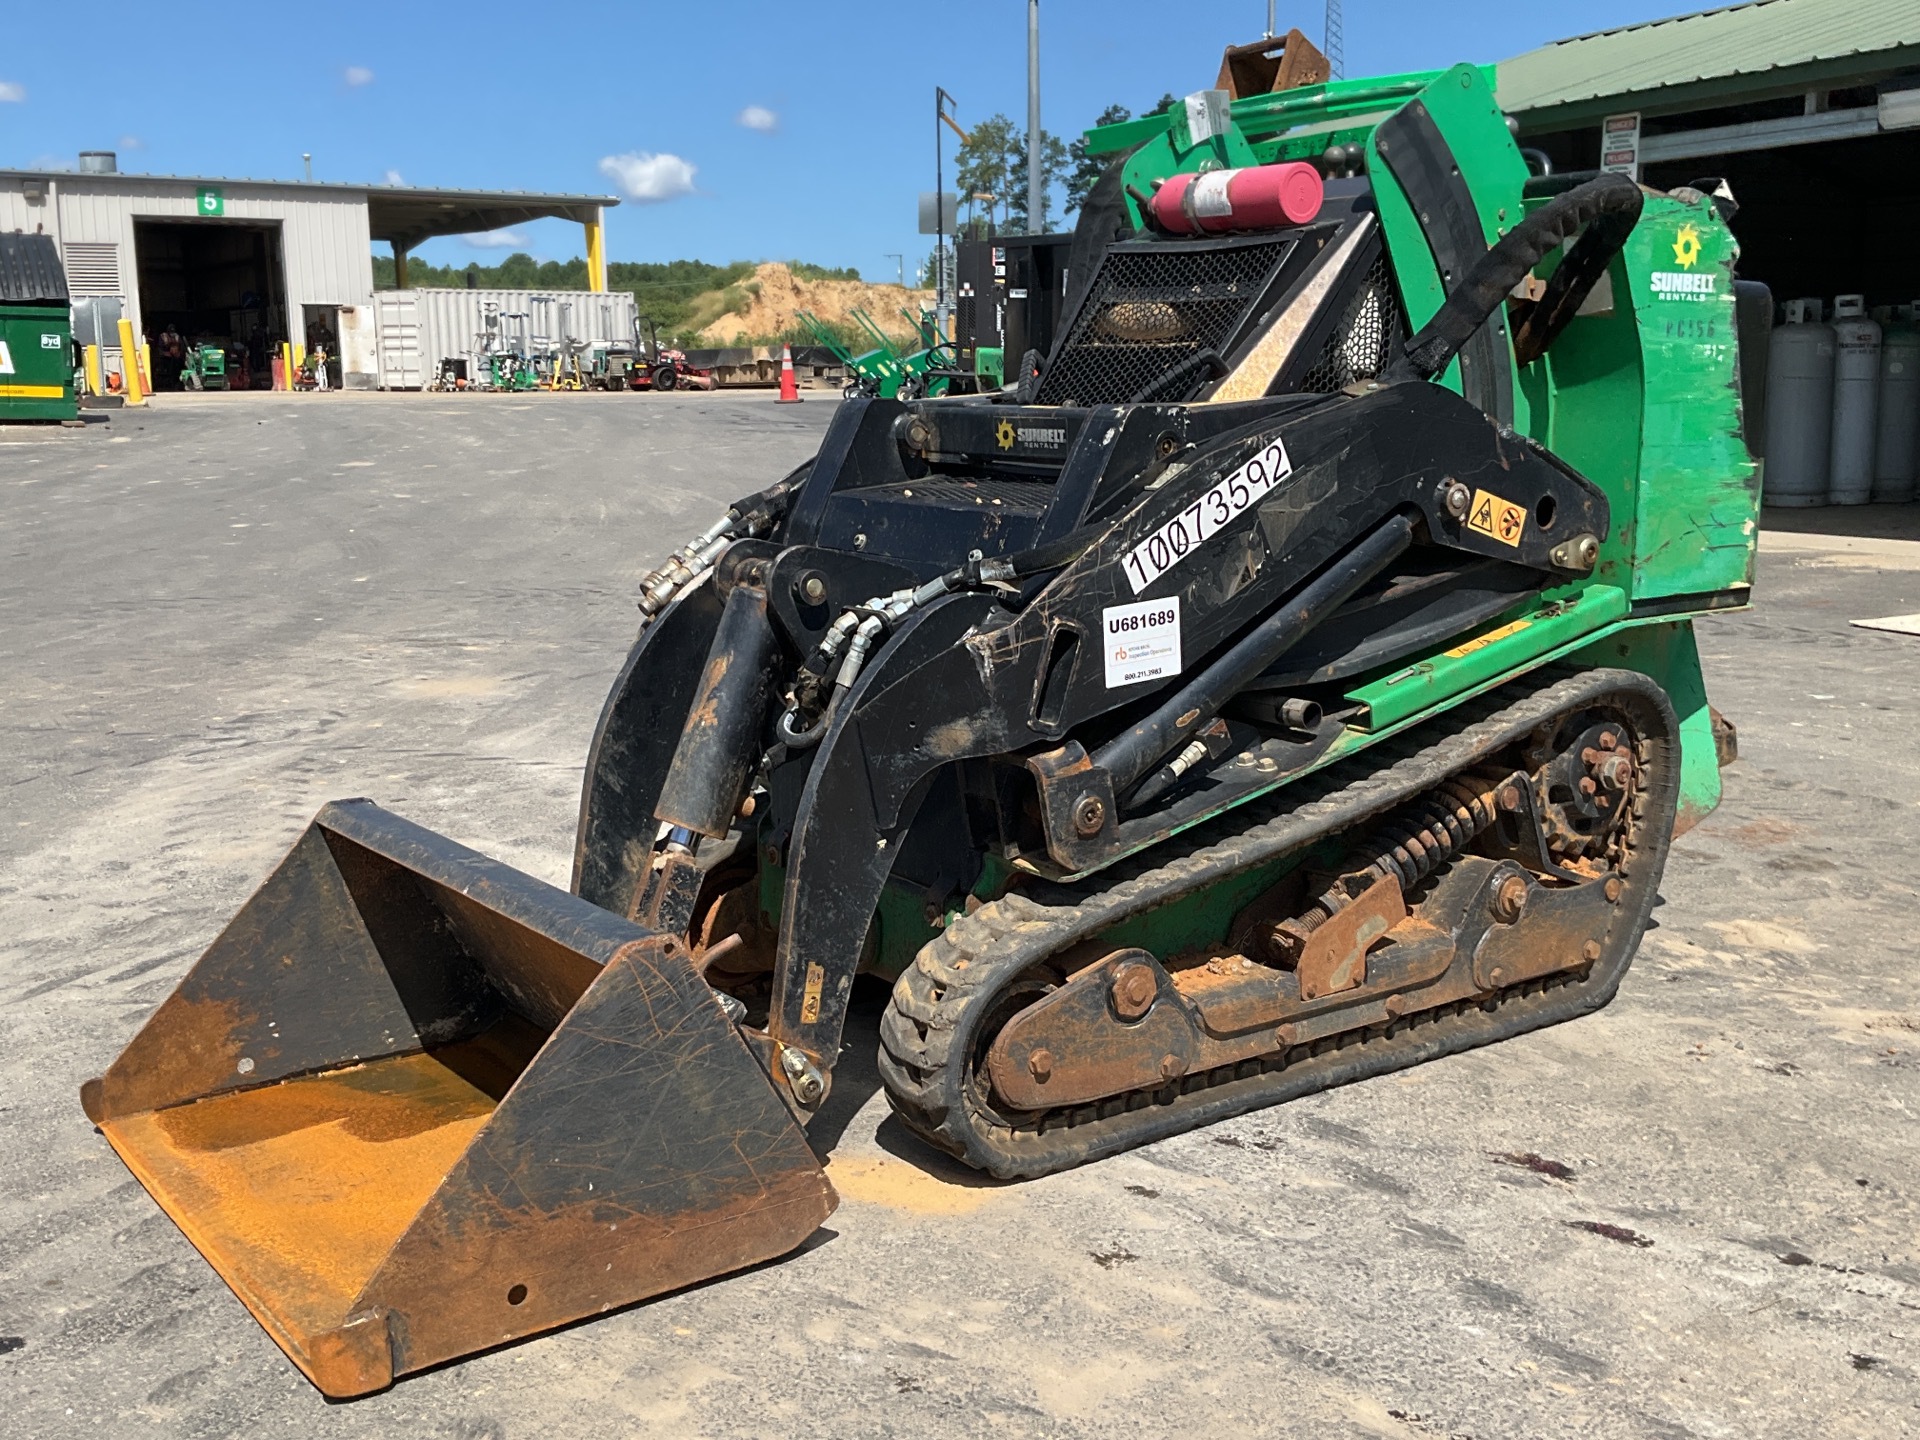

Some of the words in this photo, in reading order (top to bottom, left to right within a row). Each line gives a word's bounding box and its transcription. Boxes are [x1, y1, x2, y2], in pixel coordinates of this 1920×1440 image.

[204, 192, 217, 210] 5
[1650, 272, 1717, 293] SUNBELT
[1658, 292, 1706, 302] RENTALS
[1017, 428, 1066, 443] SUNBELT
[1024, 442, 1058, 450] RENTALS
[1129, 445, 1289, 584] 10073592
[1109, 609, 1175, 634] U681689
[1115, 647, 1128, 661] rb
[1124, 667, 1162, 681] 800.211.3983
